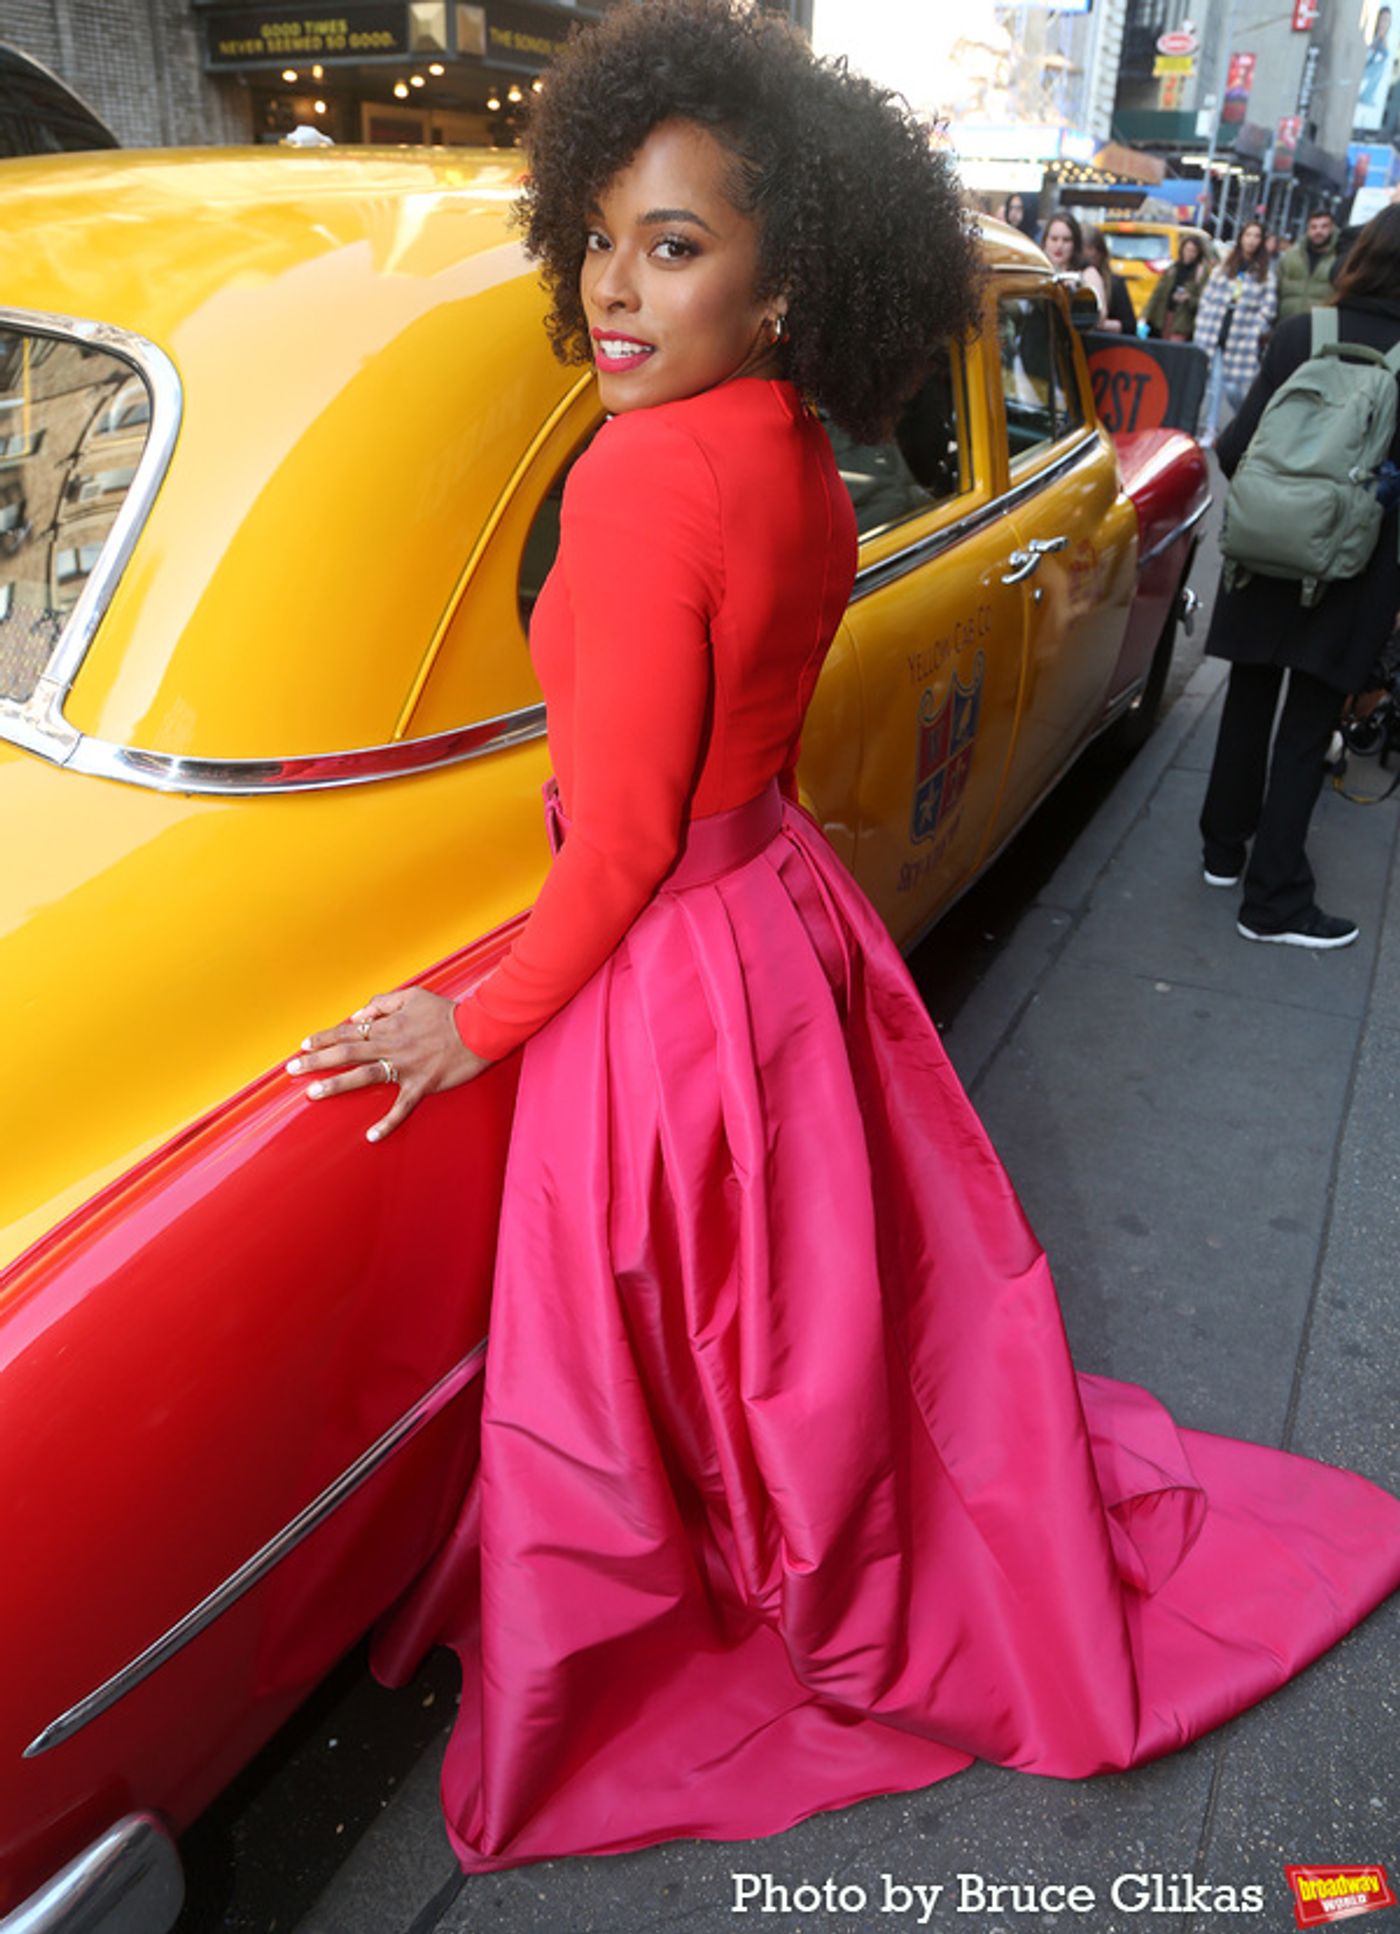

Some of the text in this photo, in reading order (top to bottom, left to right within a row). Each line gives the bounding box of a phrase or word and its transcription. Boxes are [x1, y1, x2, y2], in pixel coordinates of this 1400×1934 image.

[261, 18, 348, 37] GOOD TIMES
[489, 25, 512, 48] THE
[219, 38, 264, 54] NEVER
[266, 34, 323, 52] SEEMED
[325, 34, 347, 50] SO
